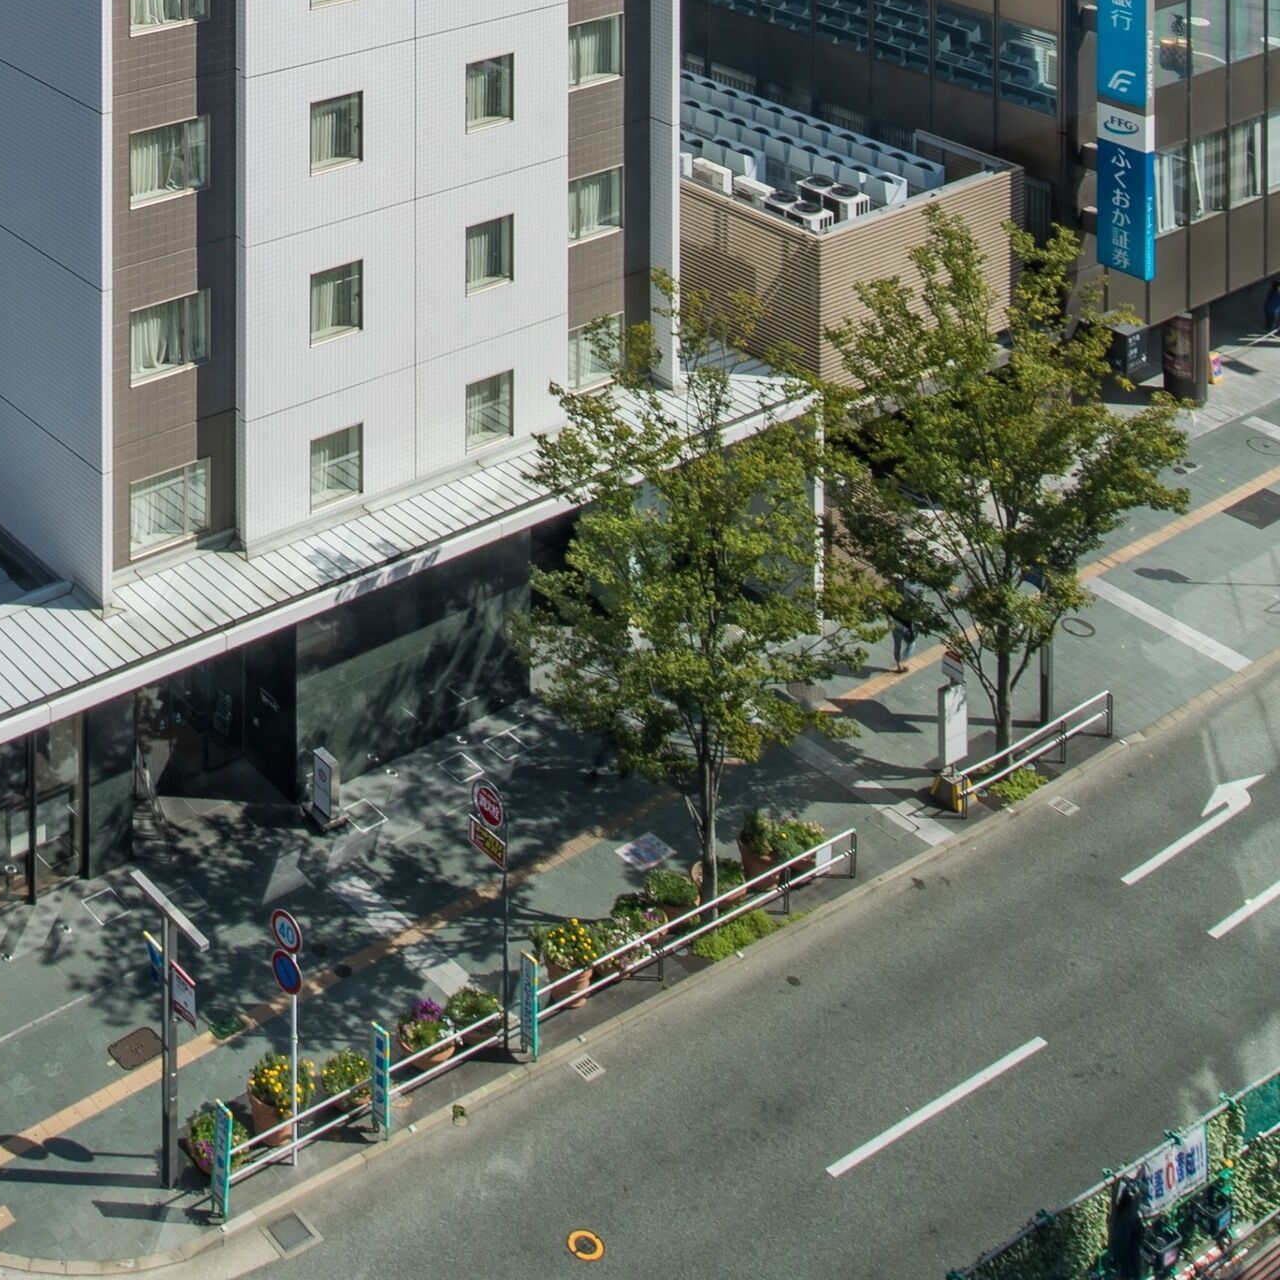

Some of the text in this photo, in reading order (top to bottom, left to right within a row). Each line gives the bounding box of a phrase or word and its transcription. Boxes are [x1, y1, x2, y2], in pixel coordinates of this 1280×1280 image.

[1109, 115, 1134, 132] FFG
[1111, 147, 1132, 270] ふくおか証券
[278, 922, 295, 945] 40
